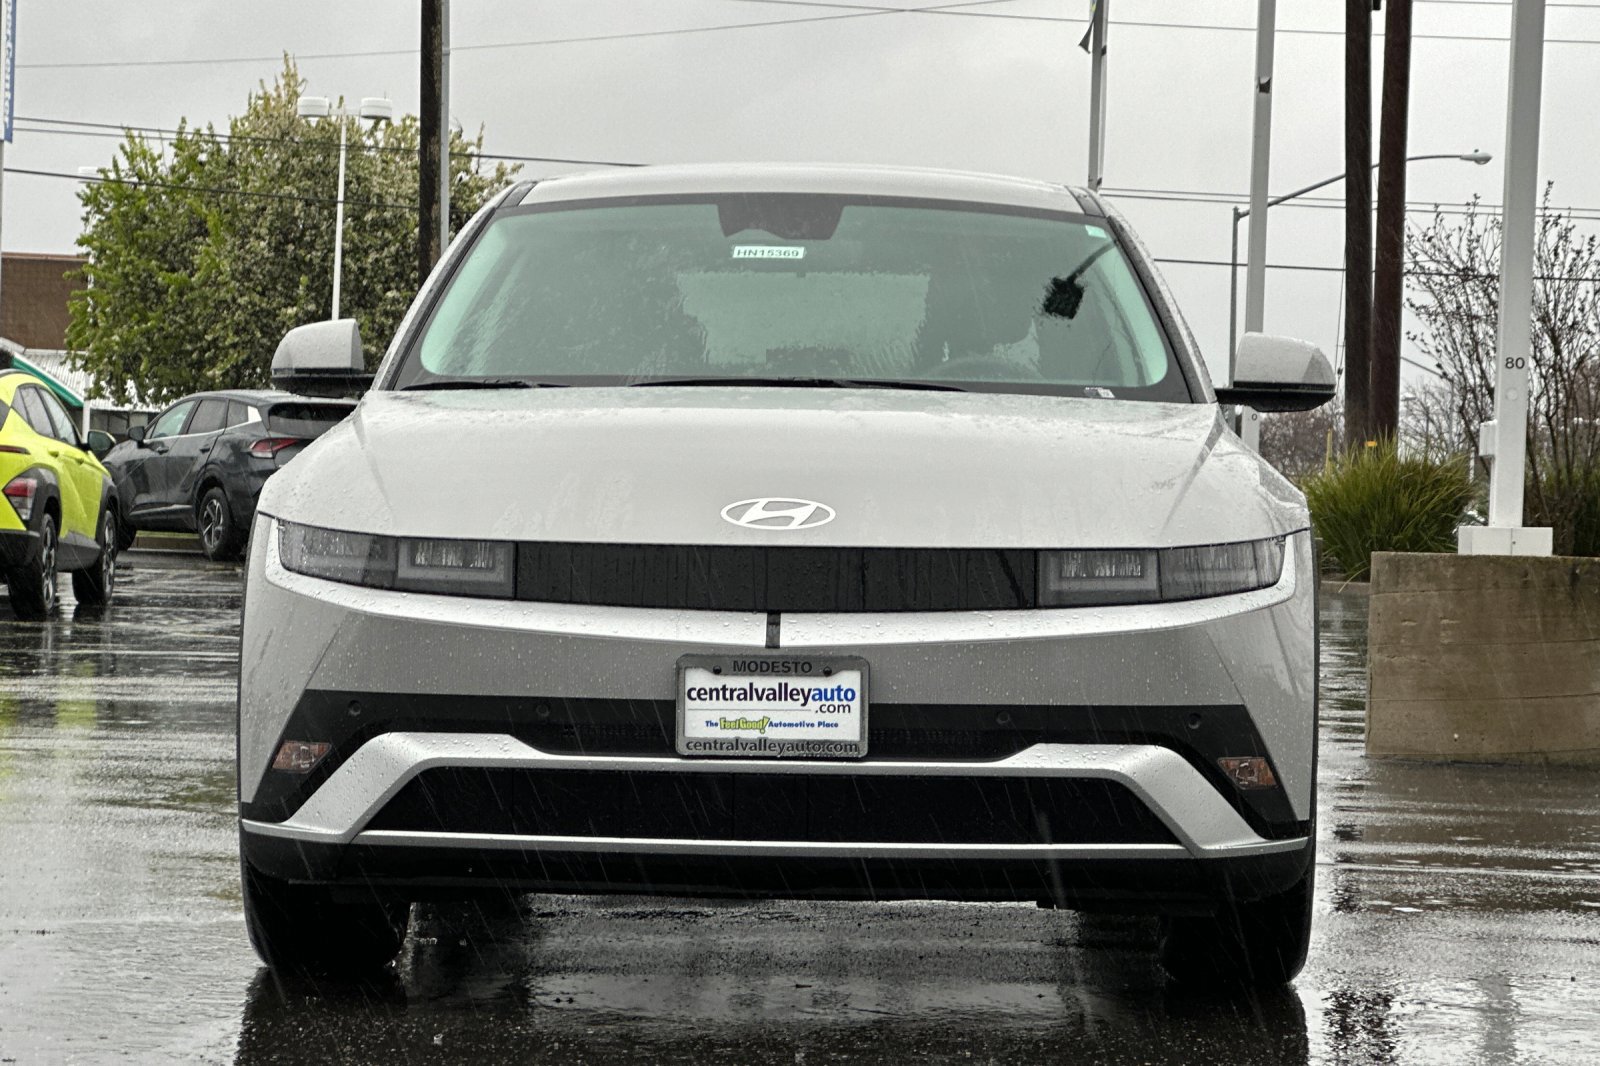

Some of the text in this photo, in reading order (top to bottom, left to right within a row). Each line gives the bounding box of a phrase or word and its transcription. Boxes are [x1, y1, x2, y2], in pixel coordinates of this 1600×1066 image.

[1505, 356, 1526, 369] 80
[732, 660, 813, 674] MODESTO
[686, 682, 856, 707] centralvalleyauto
[815, 702, 851, 714] .com
[705, 720, 719, 728] The
[768, 720, 815, 729] Automotive
[817, 720, 839, 729] Place
[685, 738, 859, 756] centralvalleyauto.com
